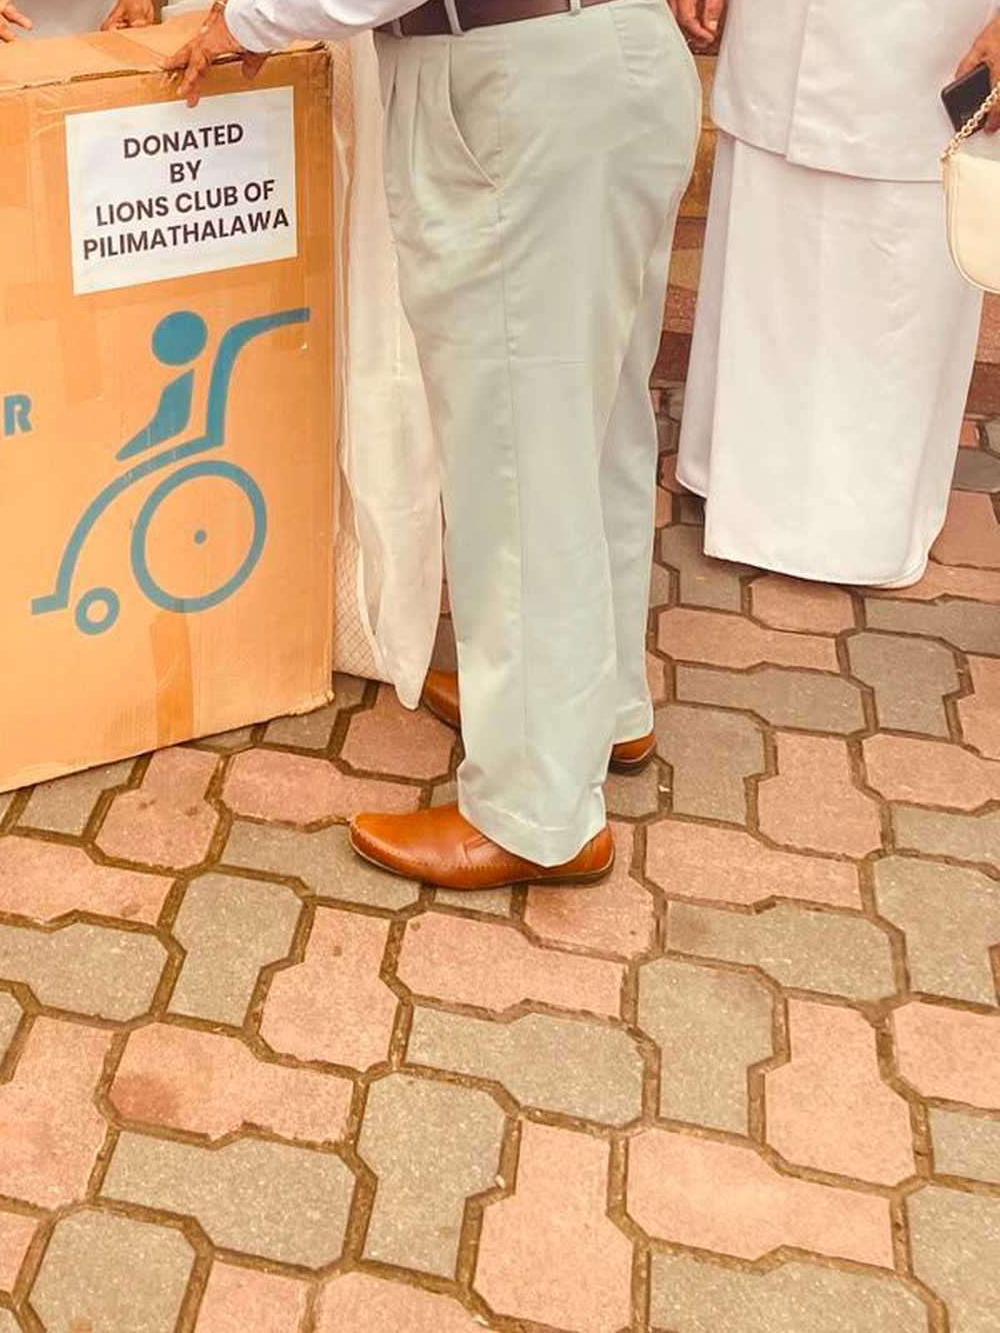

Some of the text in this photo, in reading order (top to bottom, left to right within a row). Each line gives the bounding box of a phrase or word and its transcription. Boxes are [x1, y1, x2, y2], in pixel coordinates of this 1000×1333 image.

[123, 123, 244, 159] DONATED
[169, 159, 202, 184] BY
[96, 179, 275, 227] LIONS CLUB OF
[83, 208, 289, 261] PILIMATHALAWA
